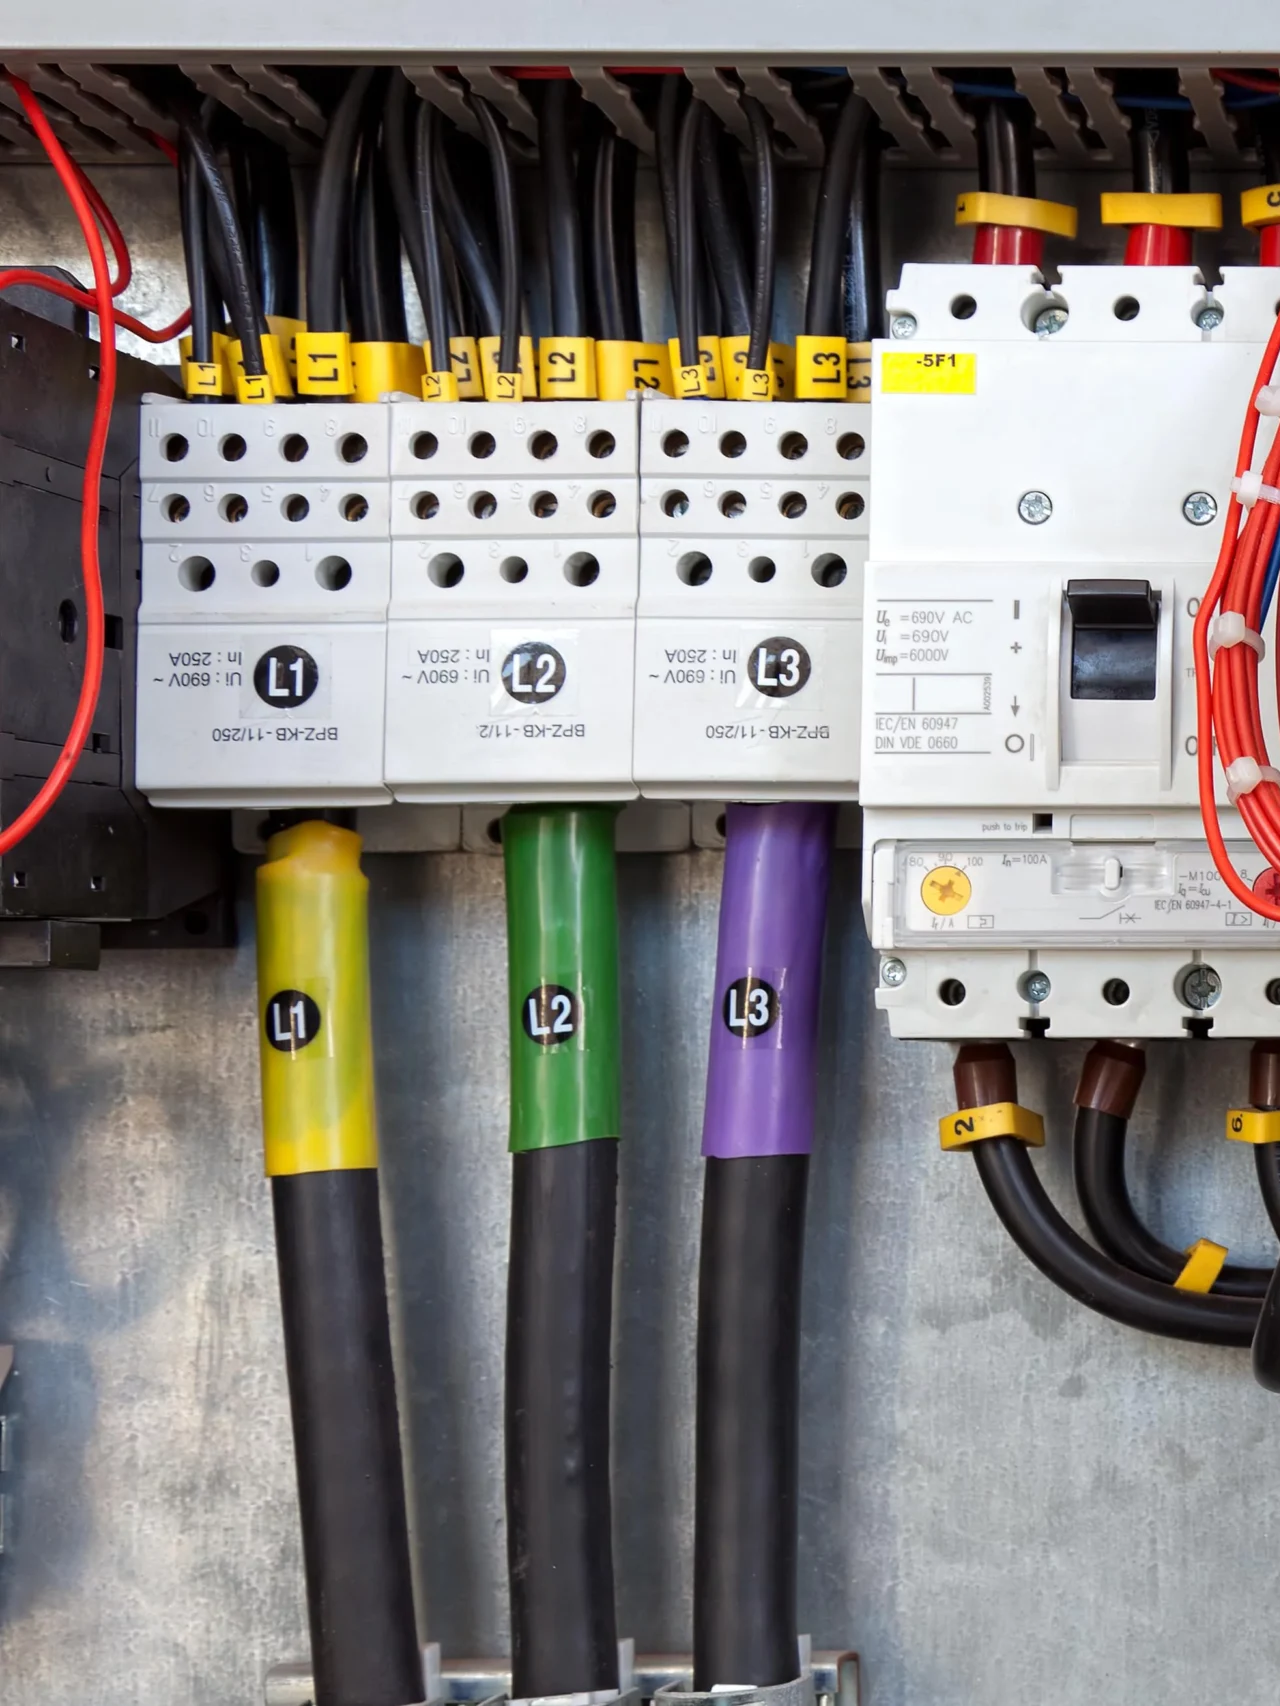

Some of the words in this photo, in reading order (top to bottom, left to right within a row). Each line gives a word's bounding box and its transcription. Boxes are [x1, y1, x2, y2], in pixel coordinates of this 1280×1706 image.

[308, 352, 338, 382] L1
[548, 351, 576, 383] L2
[813, 352, 841, 384] L3
[917, 355, 956, 368] -5F1
[198, 363, 216, 386] L1
[426, 374, 442, 398] L2
[681, 369, 700, 392] L3
[752, 373, 770, 396] L3
[245, 378, 264, 399] L1
[497, 375, 515, 400] L2
[953, 611, 972, 624] AC
[169, 652, 211, 666] 250A
[418, 650, 459, 663] 250A
[665, 650, 706, 663] 250A
[758, 648, 800, 686] L3
[268, 657, 303, 697] L1
[512, 653, 556, 692] L2
[876, 717, 916, 733] IEC/EN
[922, 718, 958, 730] 60947
[875, 736, 894, 749] DIN
[900, 736, 921, 749] VDE
[928, 736, 958, 749] 0660
[982, 824, 1000, 832] push
[1015, 823, 1027, 832] trip
[967, 858, 983, 866] 100
[1154, 900, 1181, 914] IEC/EN
[1186, 900, 1232, 910] 60947-4-1
[528, 995, 573, 1035] L2
[729, 989, 770, 1028] L3
[273, 1001, 306, 1041] L1
[955, 1116, 974, 1136] 2
